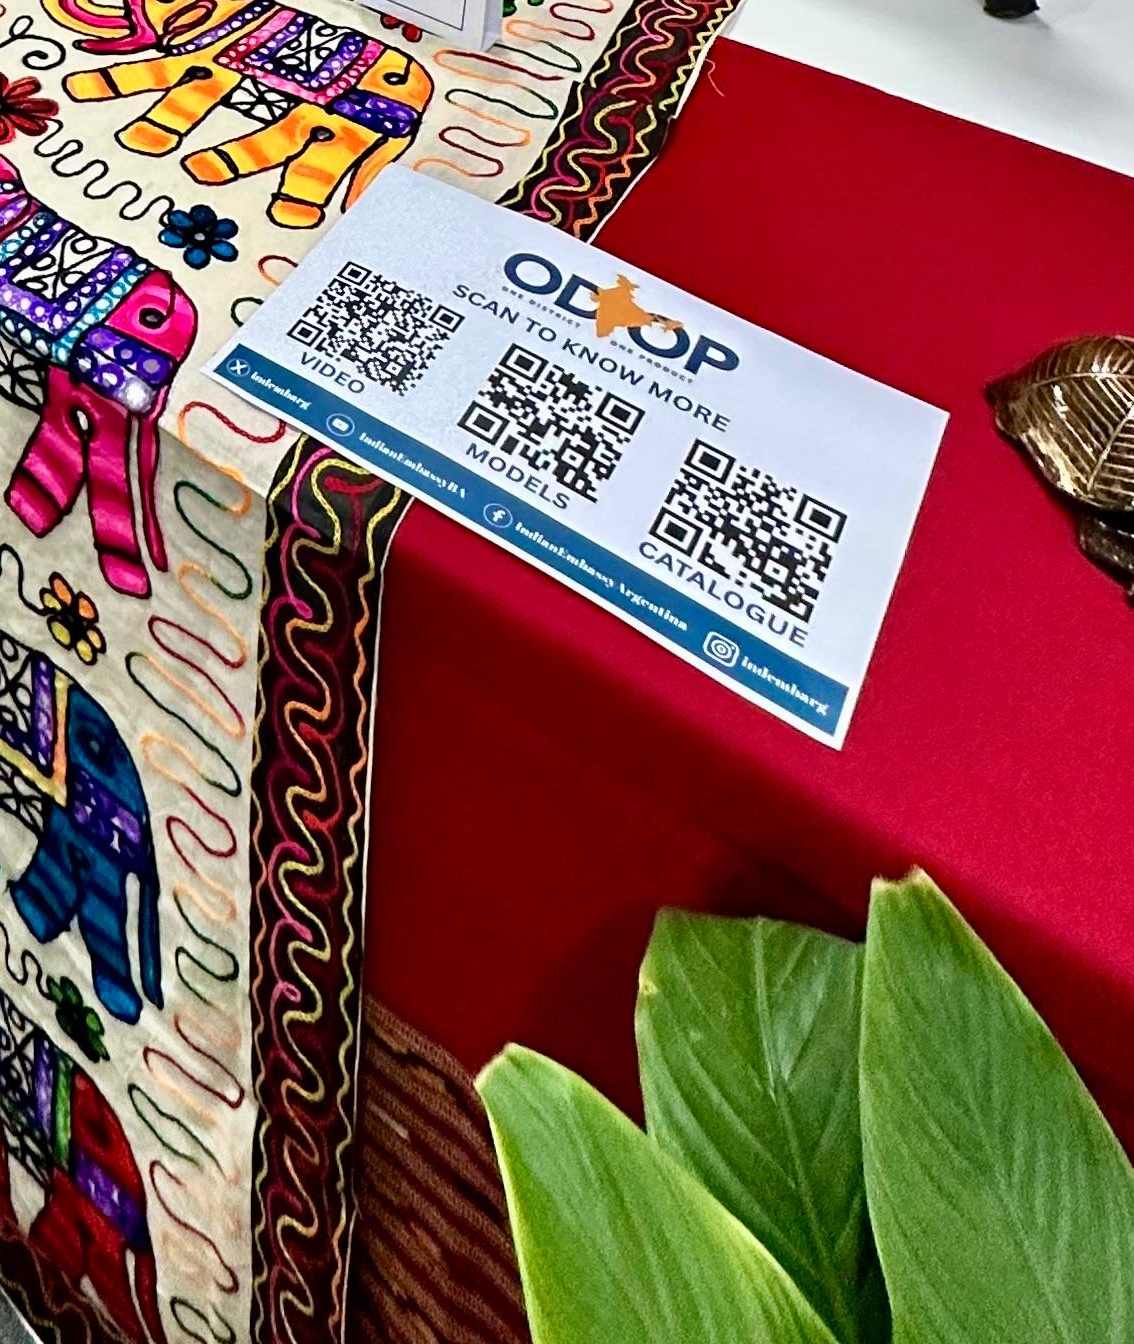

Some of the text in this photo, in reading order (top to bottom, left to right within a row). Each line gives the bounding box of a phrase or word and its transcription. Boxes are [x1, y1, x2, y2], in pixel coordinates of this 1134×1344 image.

[300, 351, 366, 394] VIDEO
[452, 284, 731, 433] SCAN TO KNOW MORE
[466, 442, 570, 510] MODELS
[638, 541, 809, 648] CATALOGUE
